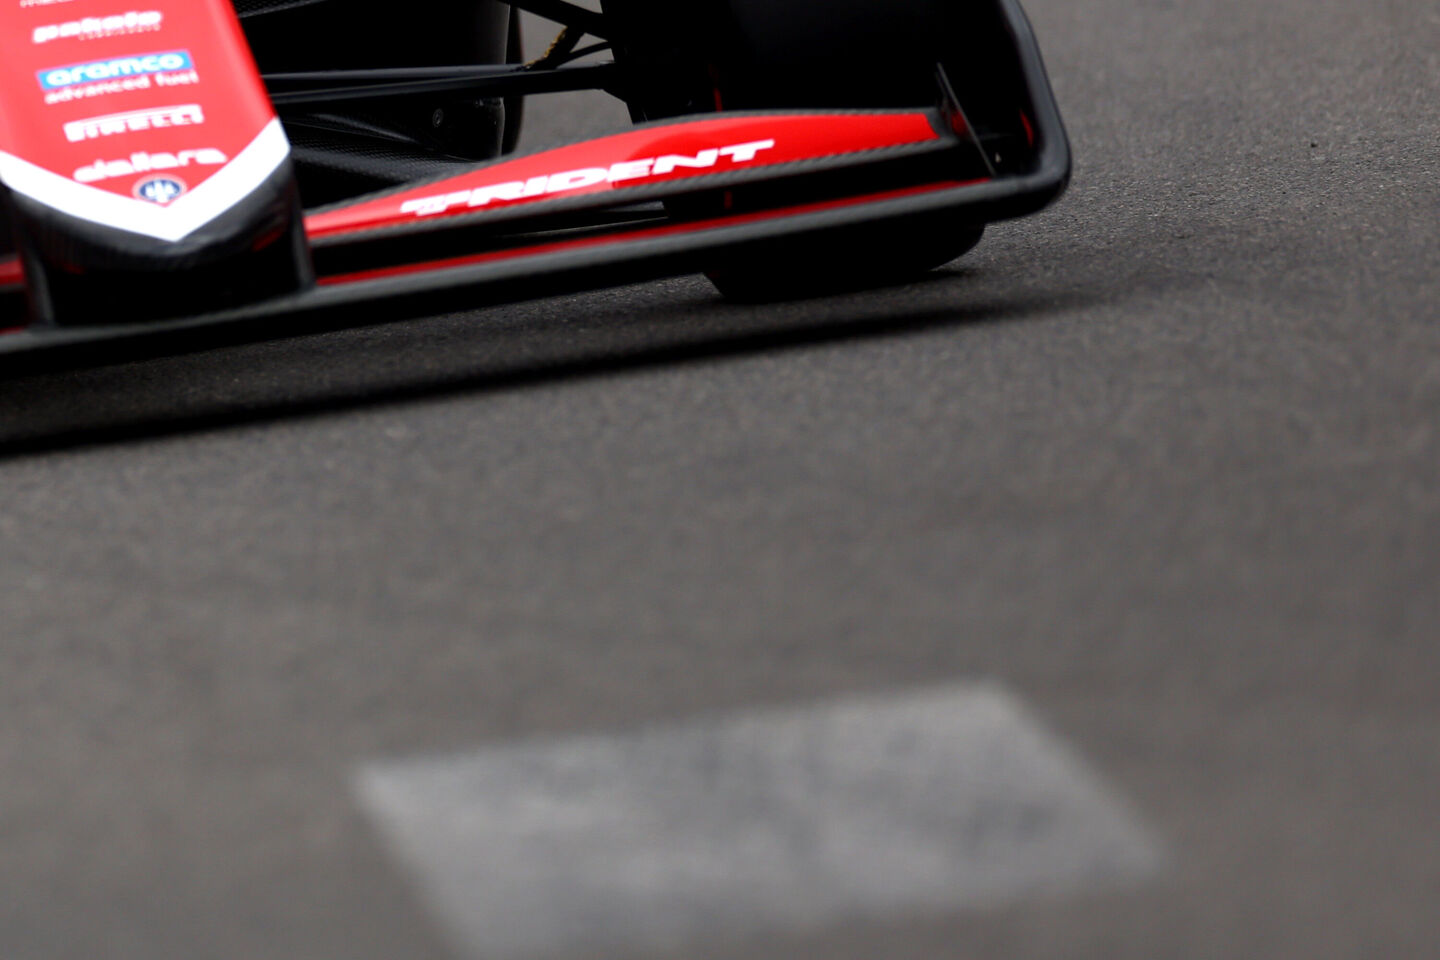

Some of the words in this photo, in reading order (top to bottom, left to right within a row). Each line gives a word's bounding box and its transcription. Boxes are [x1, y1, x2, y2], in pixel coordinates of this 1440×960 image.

[44, 75, 152, 105] advanced
[155, 70, 200, 87] fuel
[46, 53, 185, 87] aramco
[63, 103, 205, 143] PIRELLI
[399, 138, 776, 218] TRIDENT
